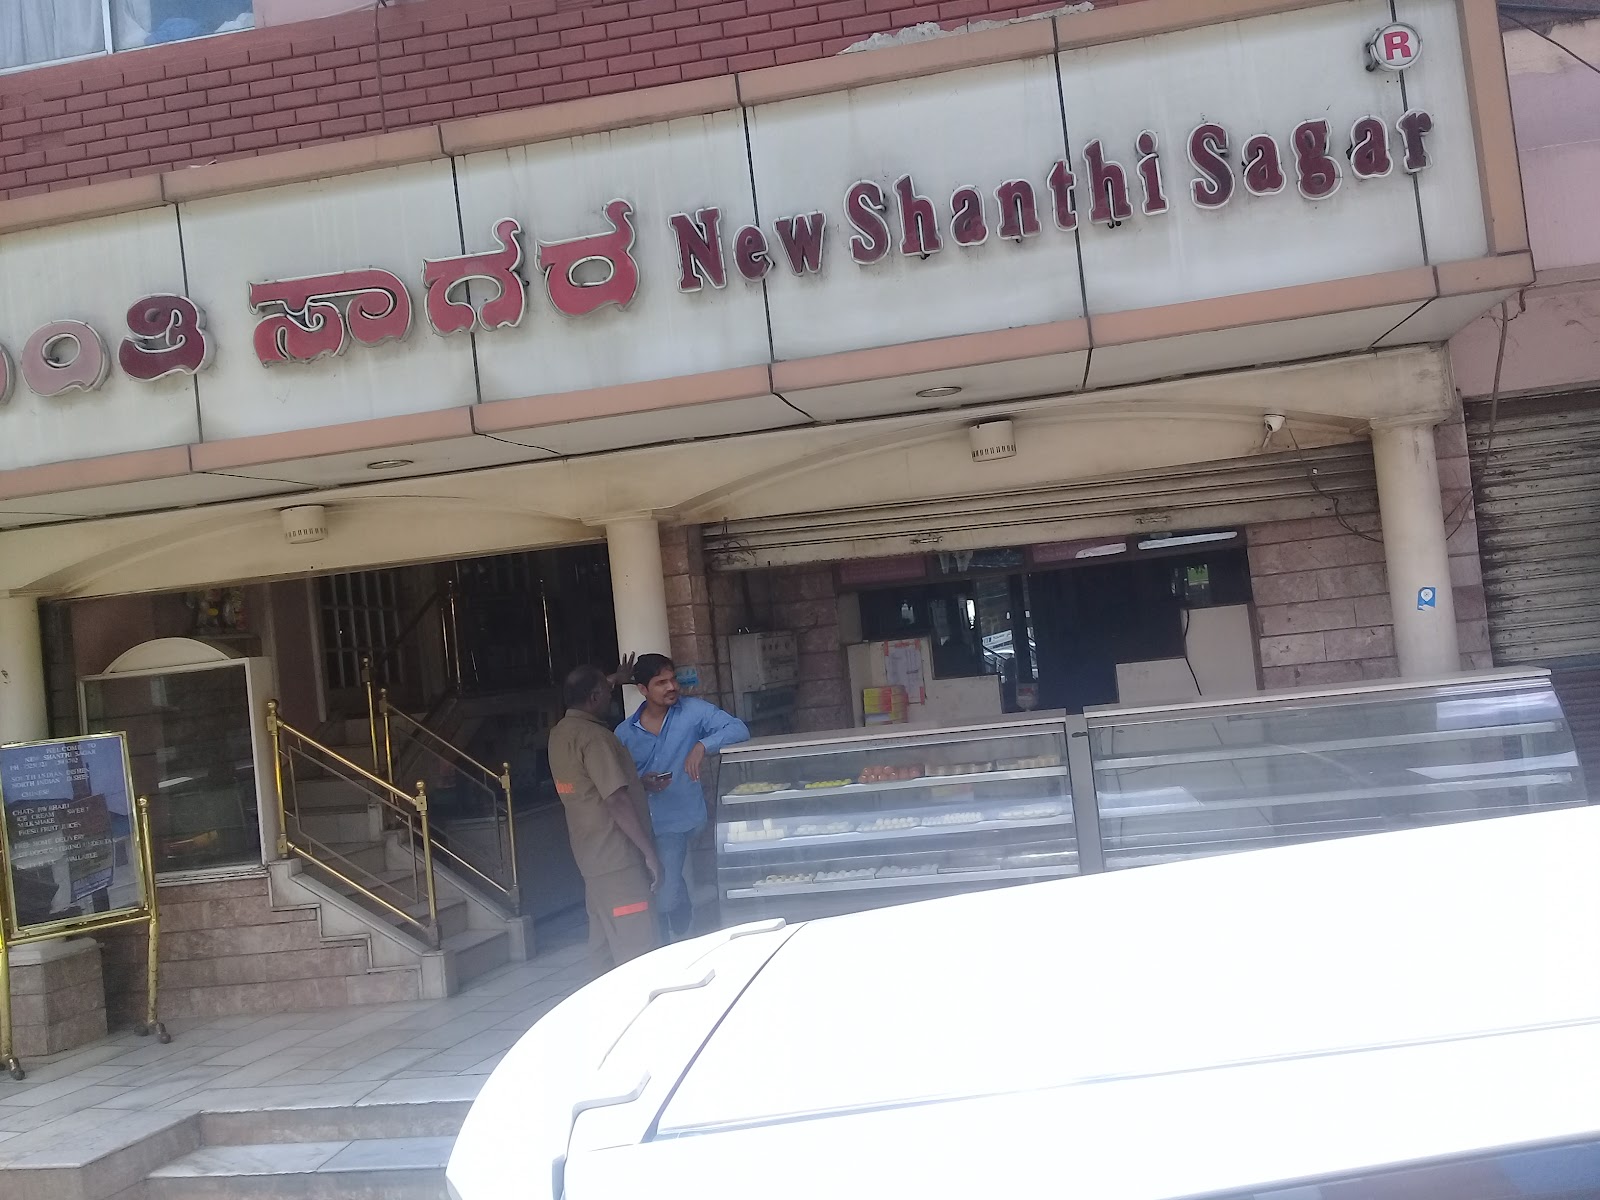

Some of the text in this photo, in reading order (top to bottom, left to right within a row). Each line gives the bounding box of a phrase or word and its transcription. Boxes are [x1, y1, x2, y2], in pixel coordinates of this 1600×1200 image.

[668, 109, 1434, 293] New Shanthi Sagar
[0, 198, 641, 415] ಂತಿ ಸಾಗರ
[46, 744, 82, 754] WELCOME
[43, 752, 71, 760] SHANTHI
[11, 780, 35, 789] NORTH
[36, 777, 60, 786] INDIAN
[12, 808, 34, 816] CHATS
[31, 812, 55, 820] CREAM
